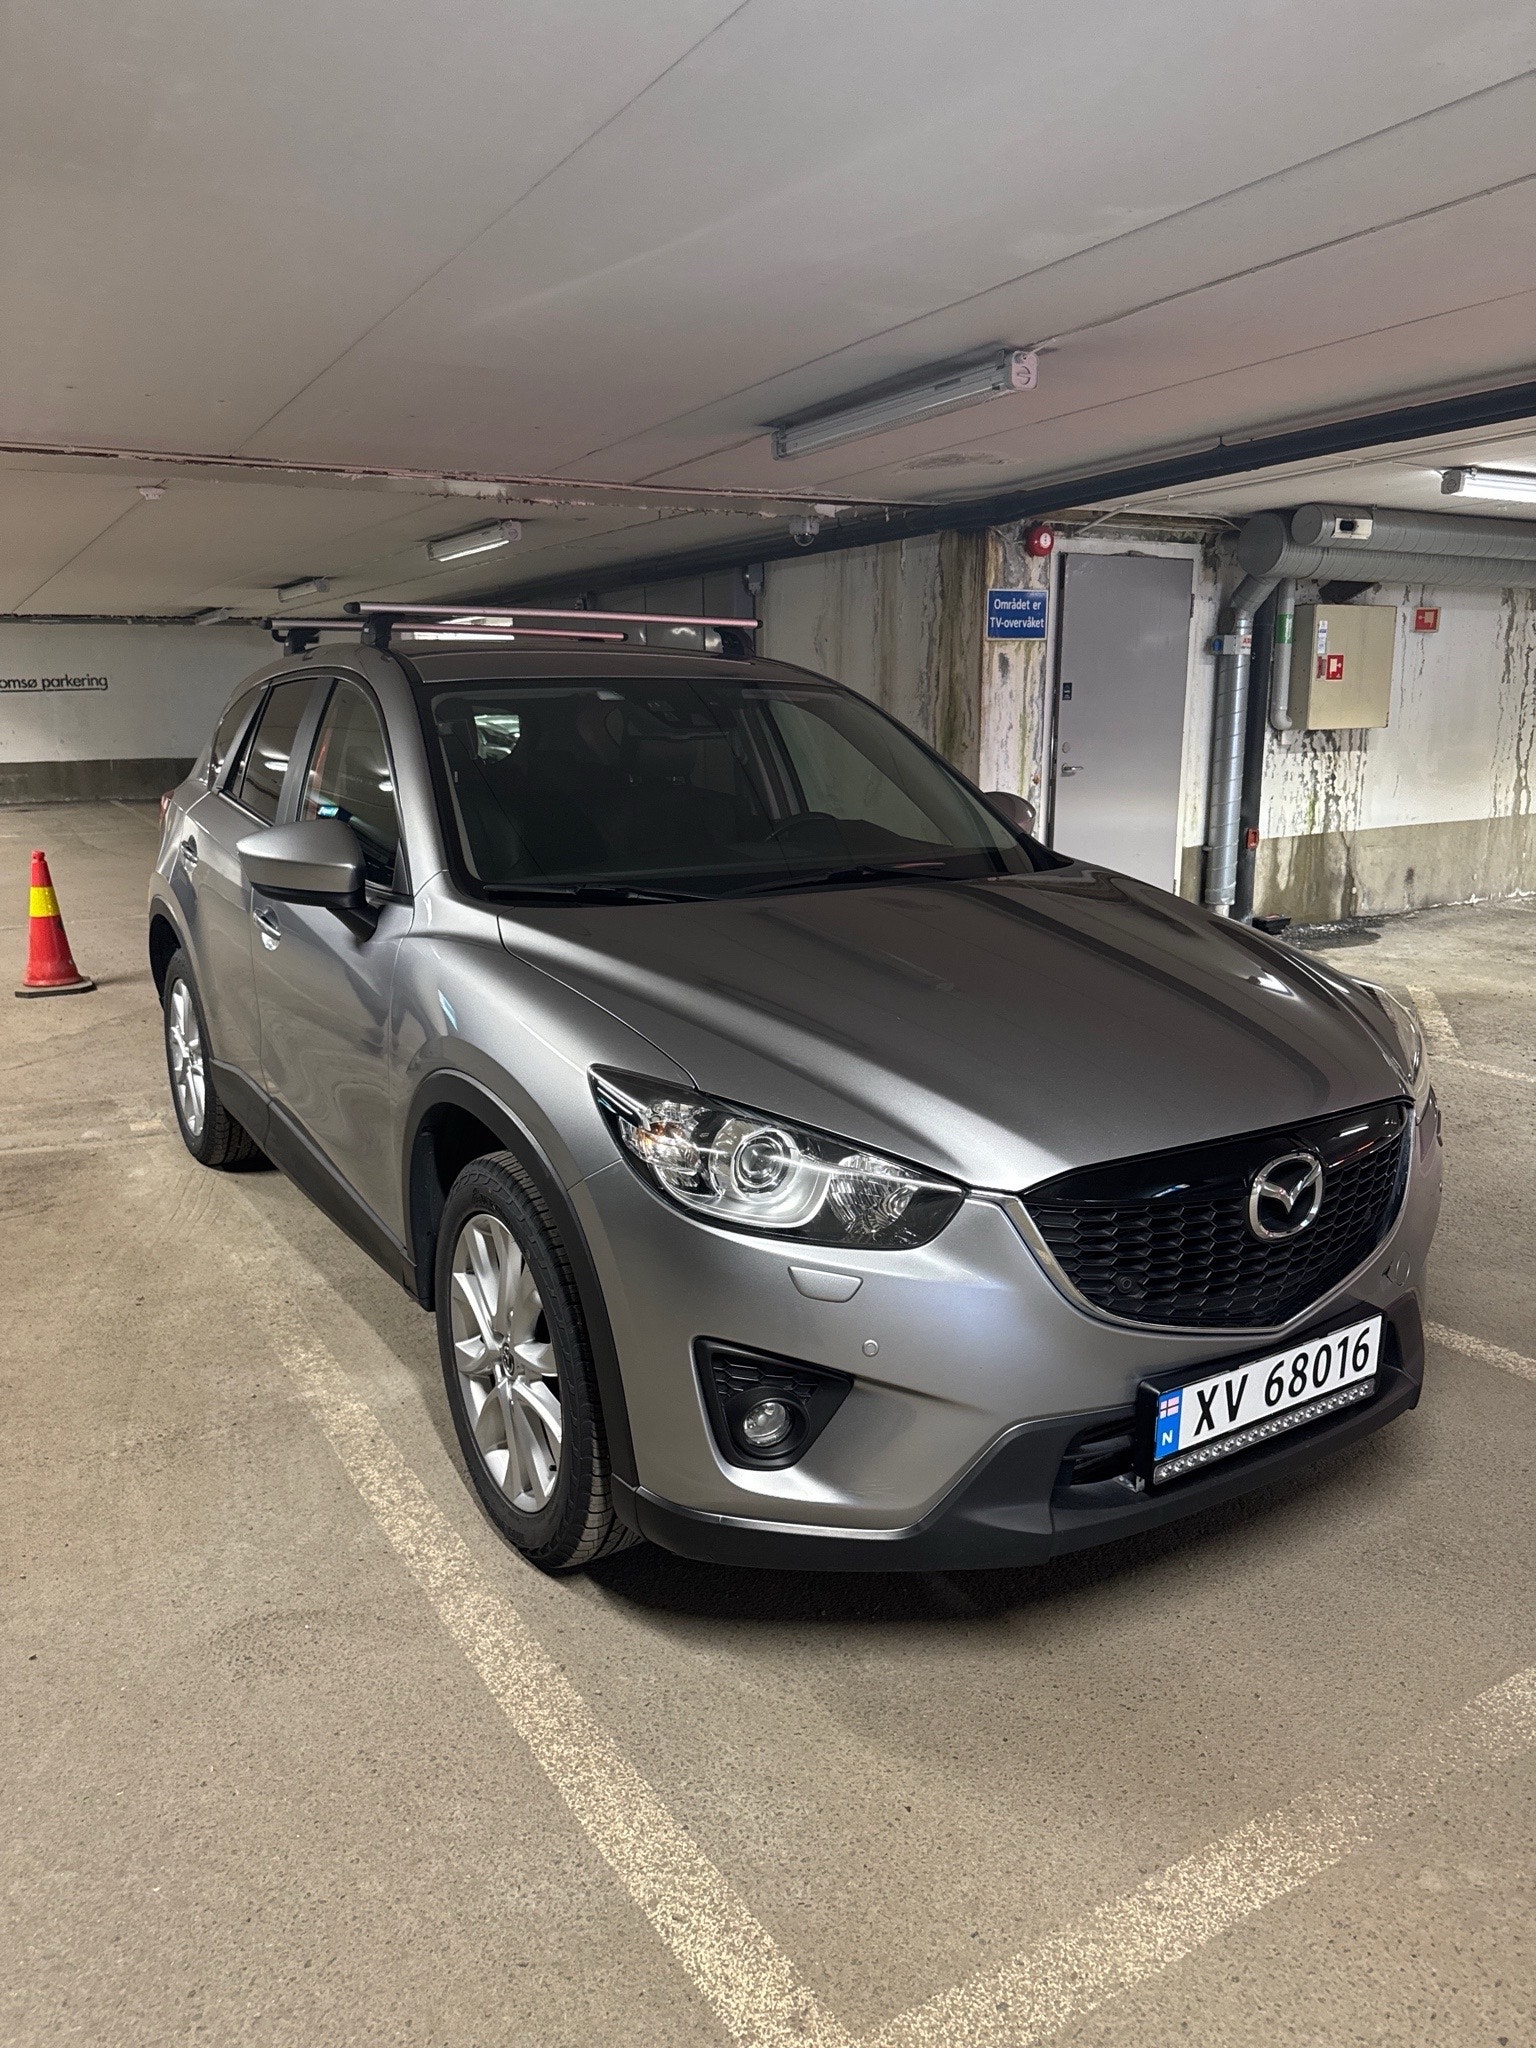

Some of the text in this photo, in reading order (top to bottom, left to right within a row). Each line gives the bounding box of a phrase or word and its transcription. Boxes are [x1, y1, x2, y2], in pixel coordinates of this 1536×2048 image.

[994, 598, 1041, 610] Området er
[990, 616, 1044, 628] TV-overvåket
[42, 674, 108, 691] parkering
[1194, 1327, 1370, 1437] XV 68016
[1161, 1430, 1173, 1446] N
